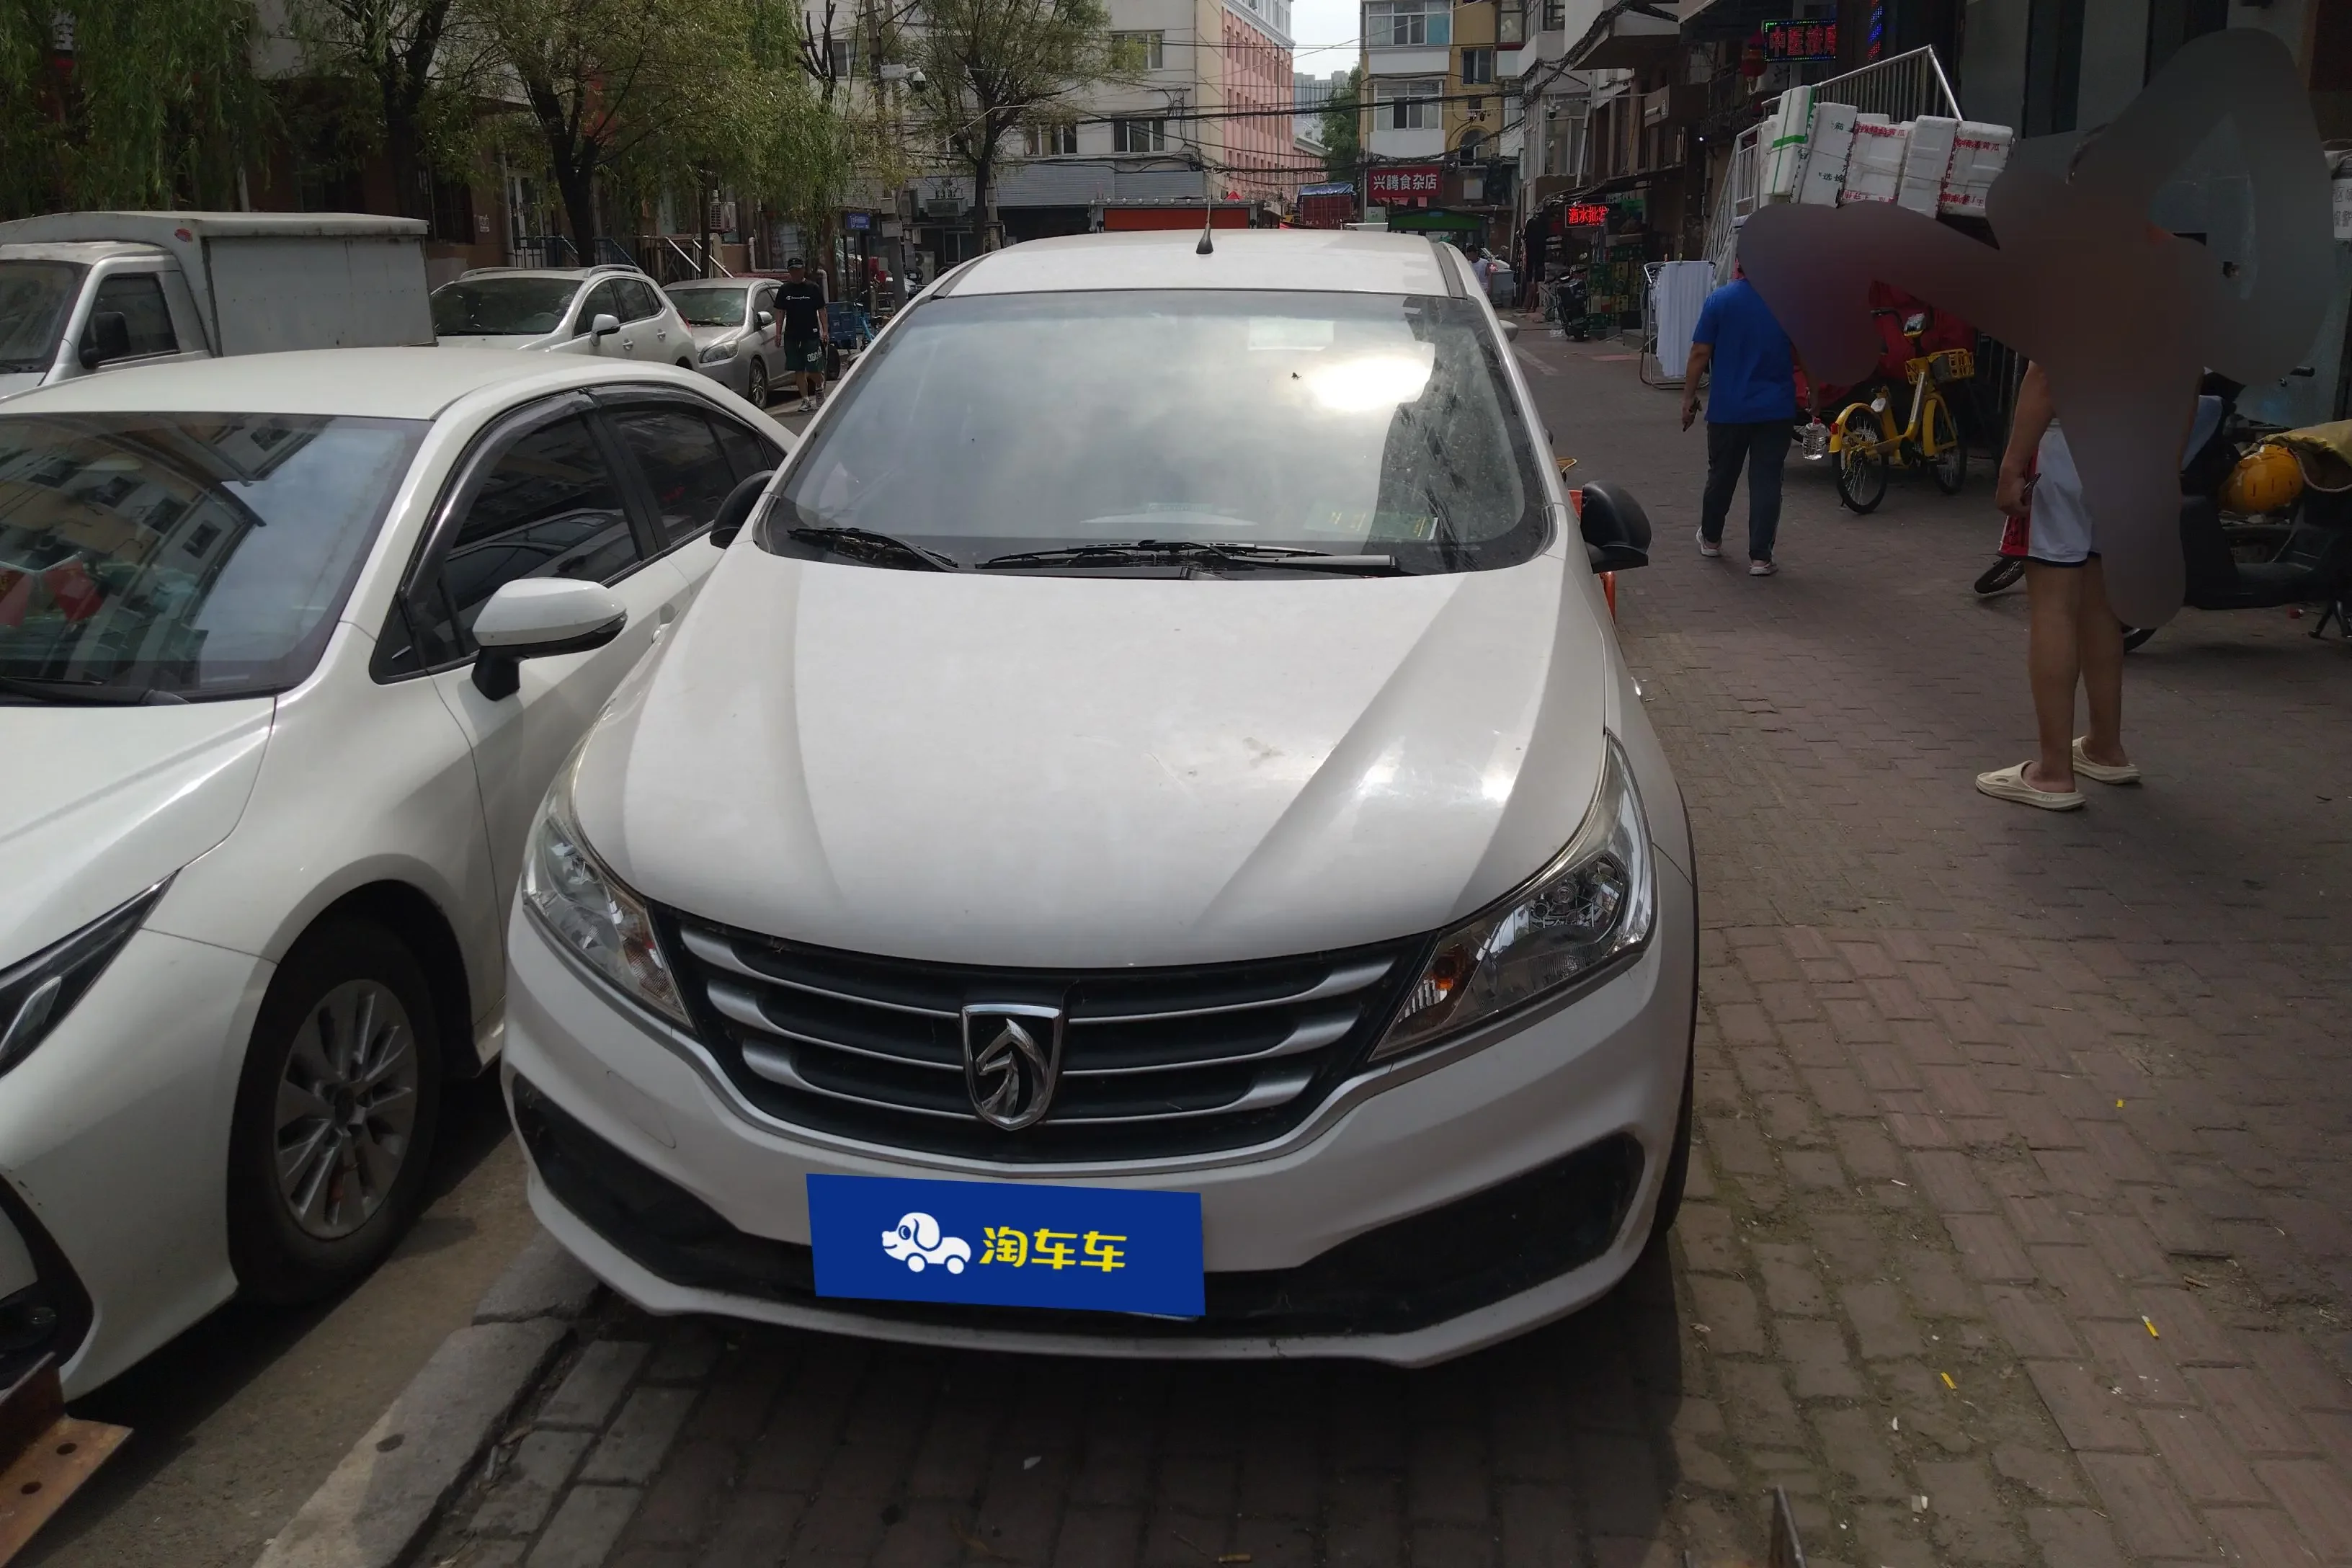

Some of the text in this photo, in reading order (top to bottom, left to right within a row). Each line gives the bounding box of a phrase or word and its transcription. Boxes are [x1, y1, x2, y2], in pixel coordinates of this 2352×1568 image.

[1373, 173, 1437, 191] 兴腾食杂店
